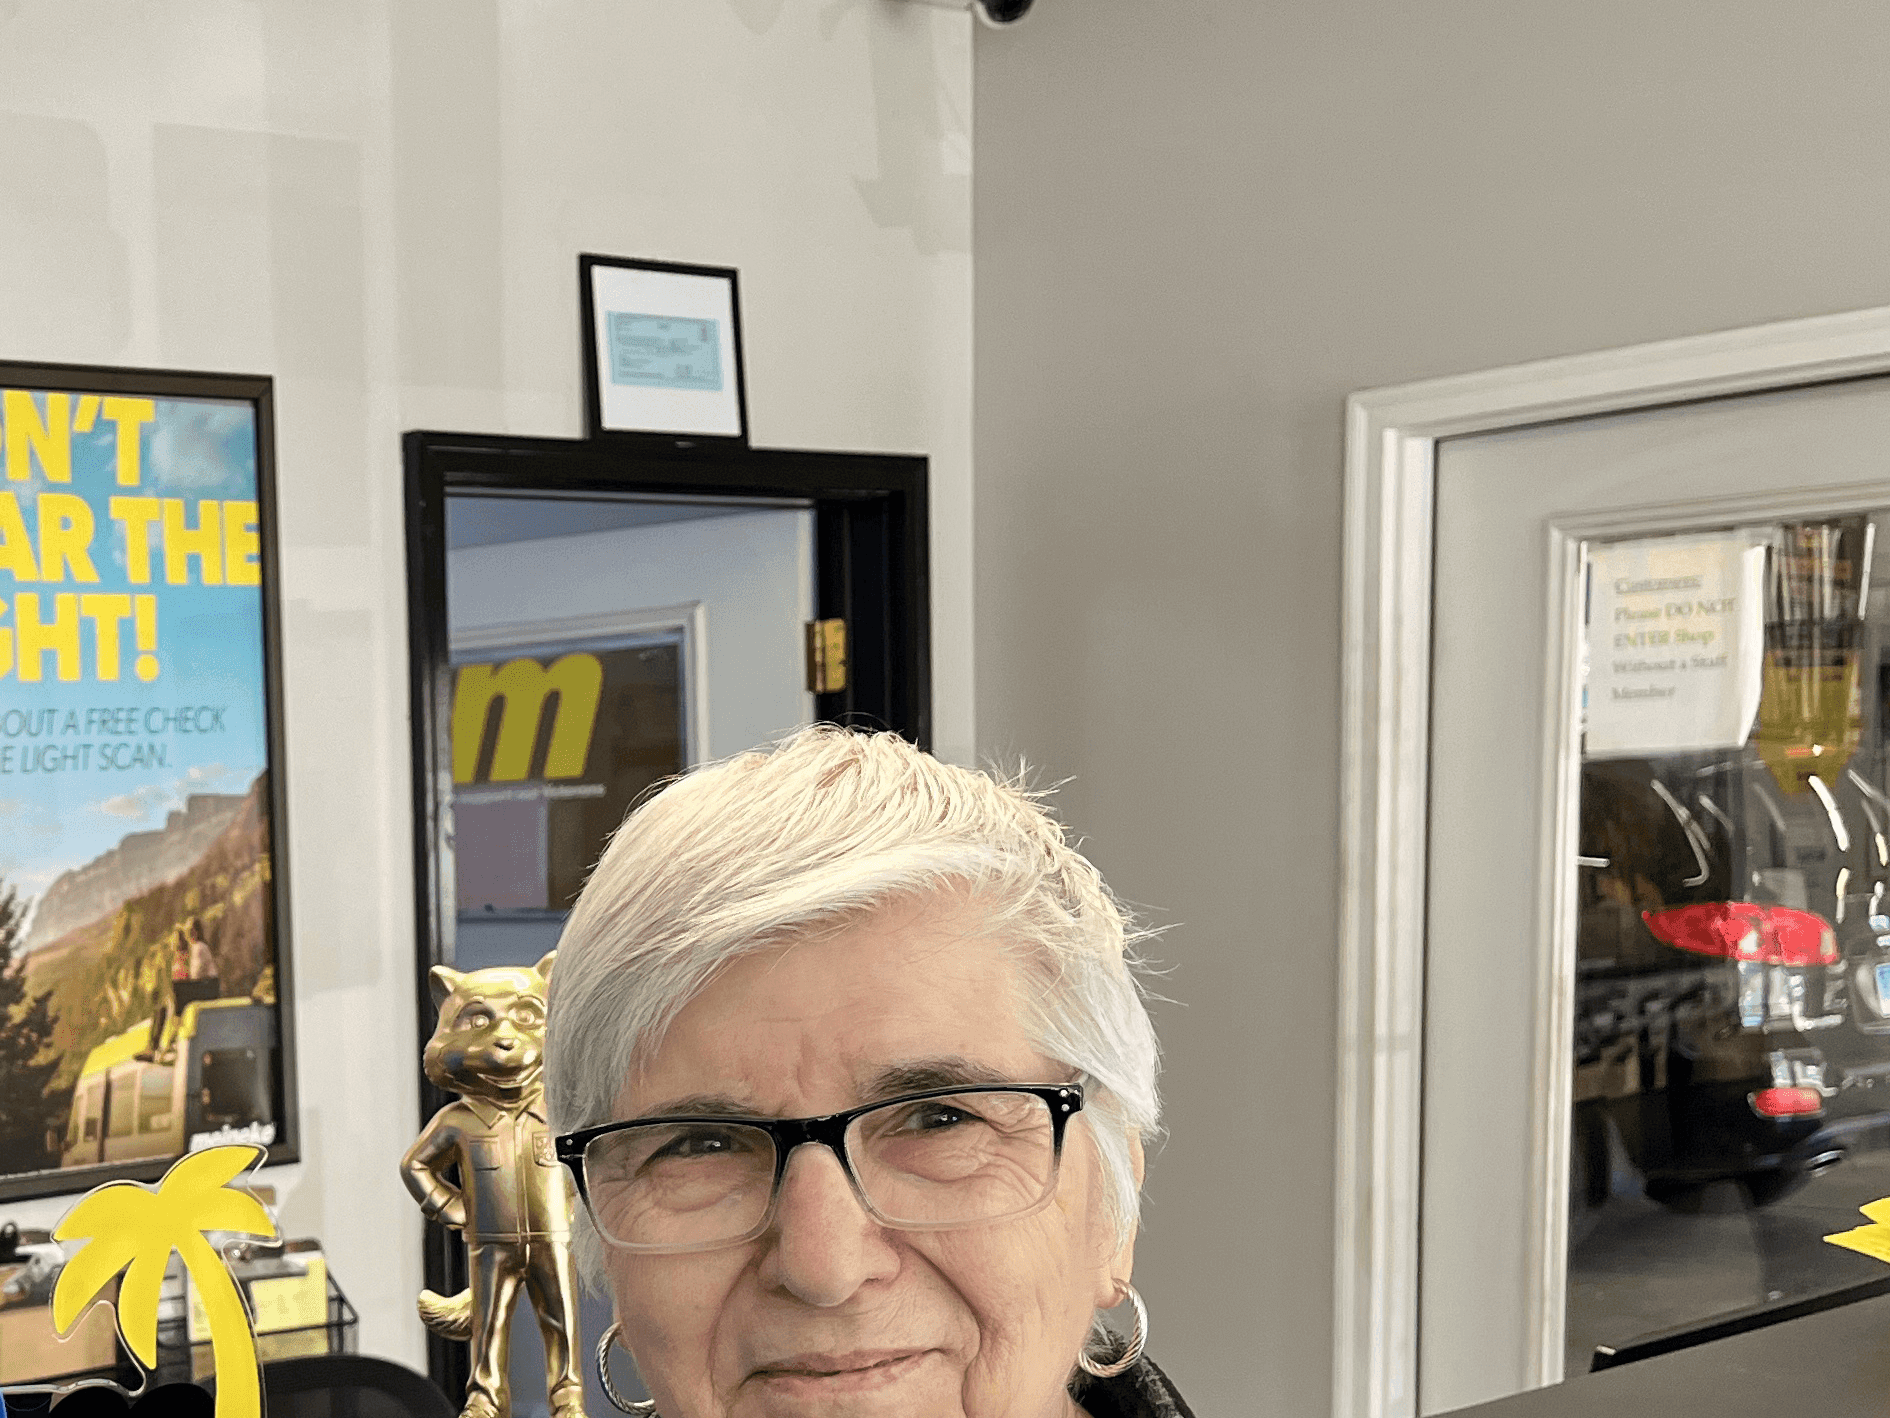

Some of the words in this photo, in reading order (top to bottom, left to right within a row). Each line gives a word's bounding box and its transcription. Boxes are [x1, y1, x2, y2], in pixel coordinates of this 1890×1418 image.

[109, 495, 263, 586] THE
[60, 708, 82, 737] A
[84, 706, 138, 736] FREE
[144, 704, 229, 735] CHECK
[22, 743, 94, 775] LIGHT
[97, 742, 173, 771] SCAN.
